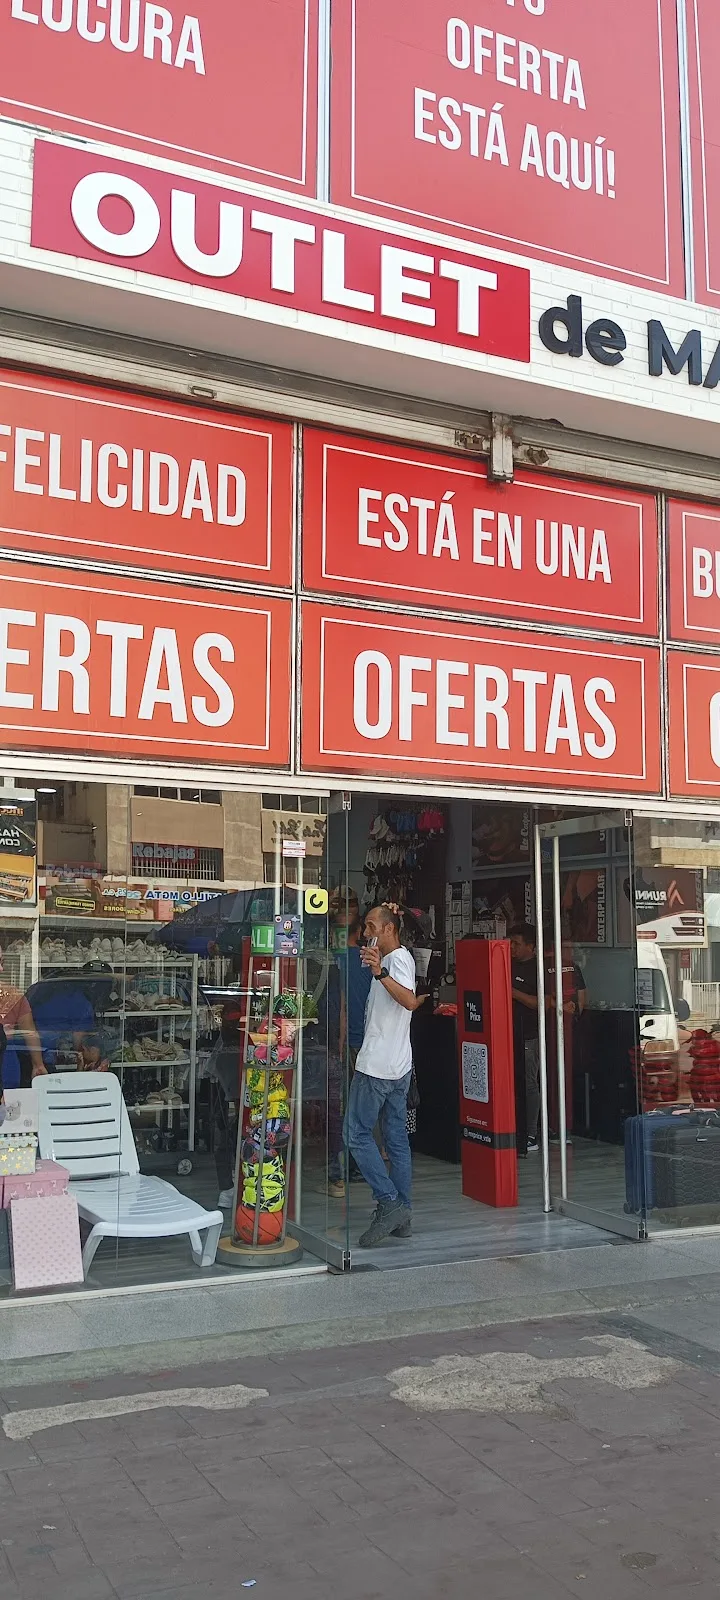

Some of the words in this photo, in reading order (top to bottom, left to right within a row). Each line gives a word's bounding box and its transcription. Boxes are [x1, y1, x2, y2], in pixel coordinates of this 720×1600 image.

[447, 18, 586, 110] OFERTA
[415, 80, 509, 166] ESTÁ
[520, 124, 615, 198] AQUÍ!
[71, 171, 498, 336] OUTLET
[539, 295, 626, 366] de
[359, 488, 459, 560] ESTÁ
[474, 509, 521, 569] EN
[537, 520, 611, 583] UNA
[693, 547, 720, 601] B
[0, 608, 234, 726] ERTAS
[354, 650, 616, 758] OFERTAS
[132, 842, 196, 863] Rebajas
[596, 874, 605, 943] CATERPILLAR
[469, 1011, 481, 1022] Price
